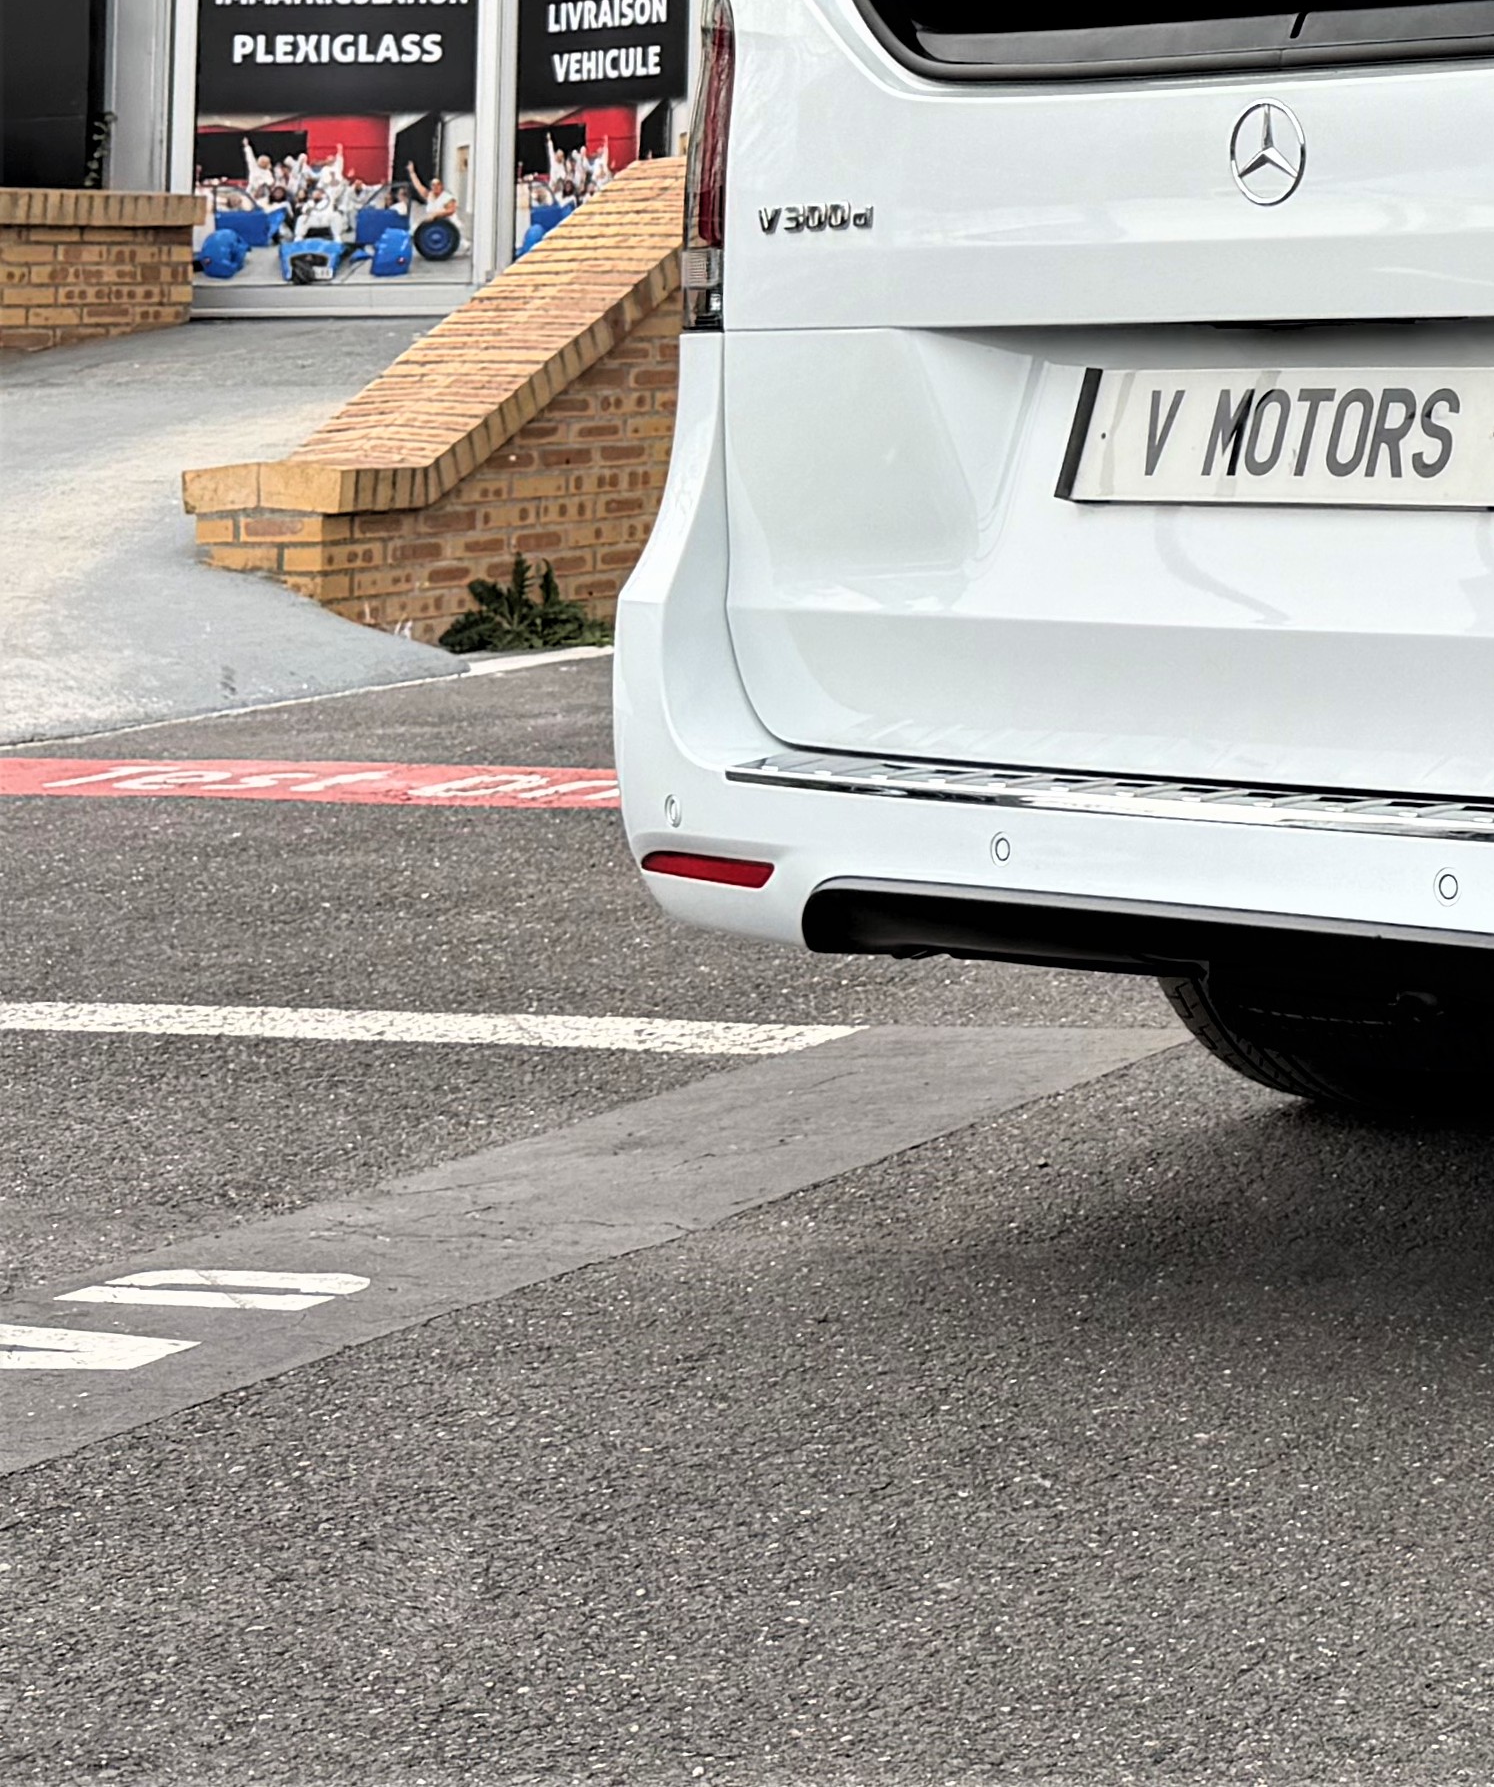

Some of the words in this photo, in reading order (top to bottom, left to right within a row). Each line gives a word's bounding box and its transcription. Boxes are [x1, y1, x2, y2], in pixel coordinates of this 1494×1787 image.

[232, 33, 442, 64] PLEXIGLASS
[552, 45, 661, 83] VEHICULE
[1144, 389, 1186, 477] V
[1200, 387, 1462, 479] MOTORS
